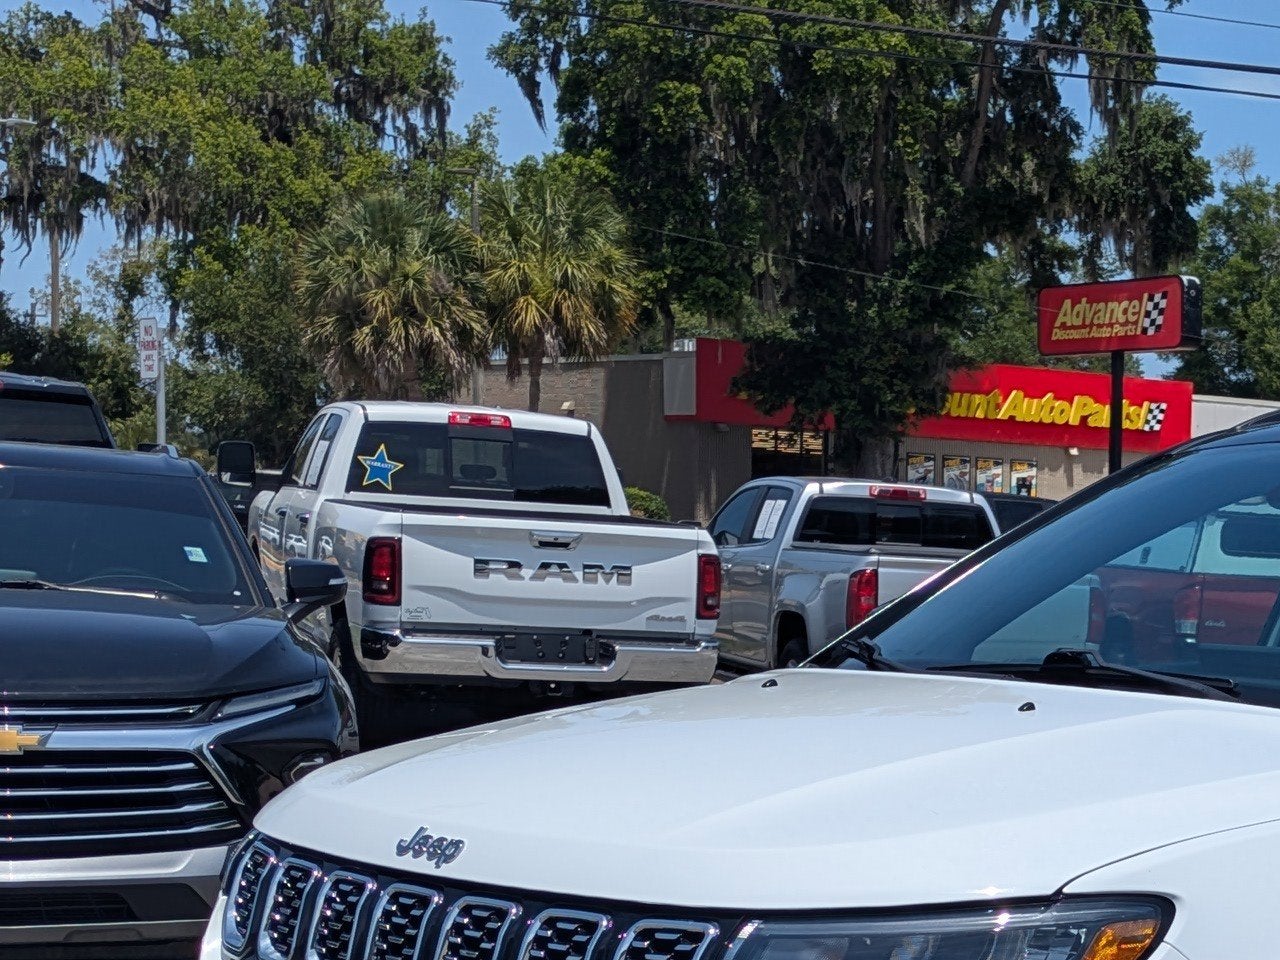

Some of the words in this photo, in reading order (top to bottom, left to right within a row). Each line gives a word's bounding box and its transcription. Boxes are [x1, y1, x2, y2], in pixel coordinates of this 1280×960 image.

[1054, 297, 1140, 328] Advance
[144, 325, 153, 336] NO
[1051, 327, 1089, 340] Discount
[1090, 325, 1112, 339] Auto
[1111, 324, 1137, 337] Parts
[997, 390, 1071, 425] Auto
[473, 557, 633, 586] RAM
[396, 826, 465, 869] Jeep
